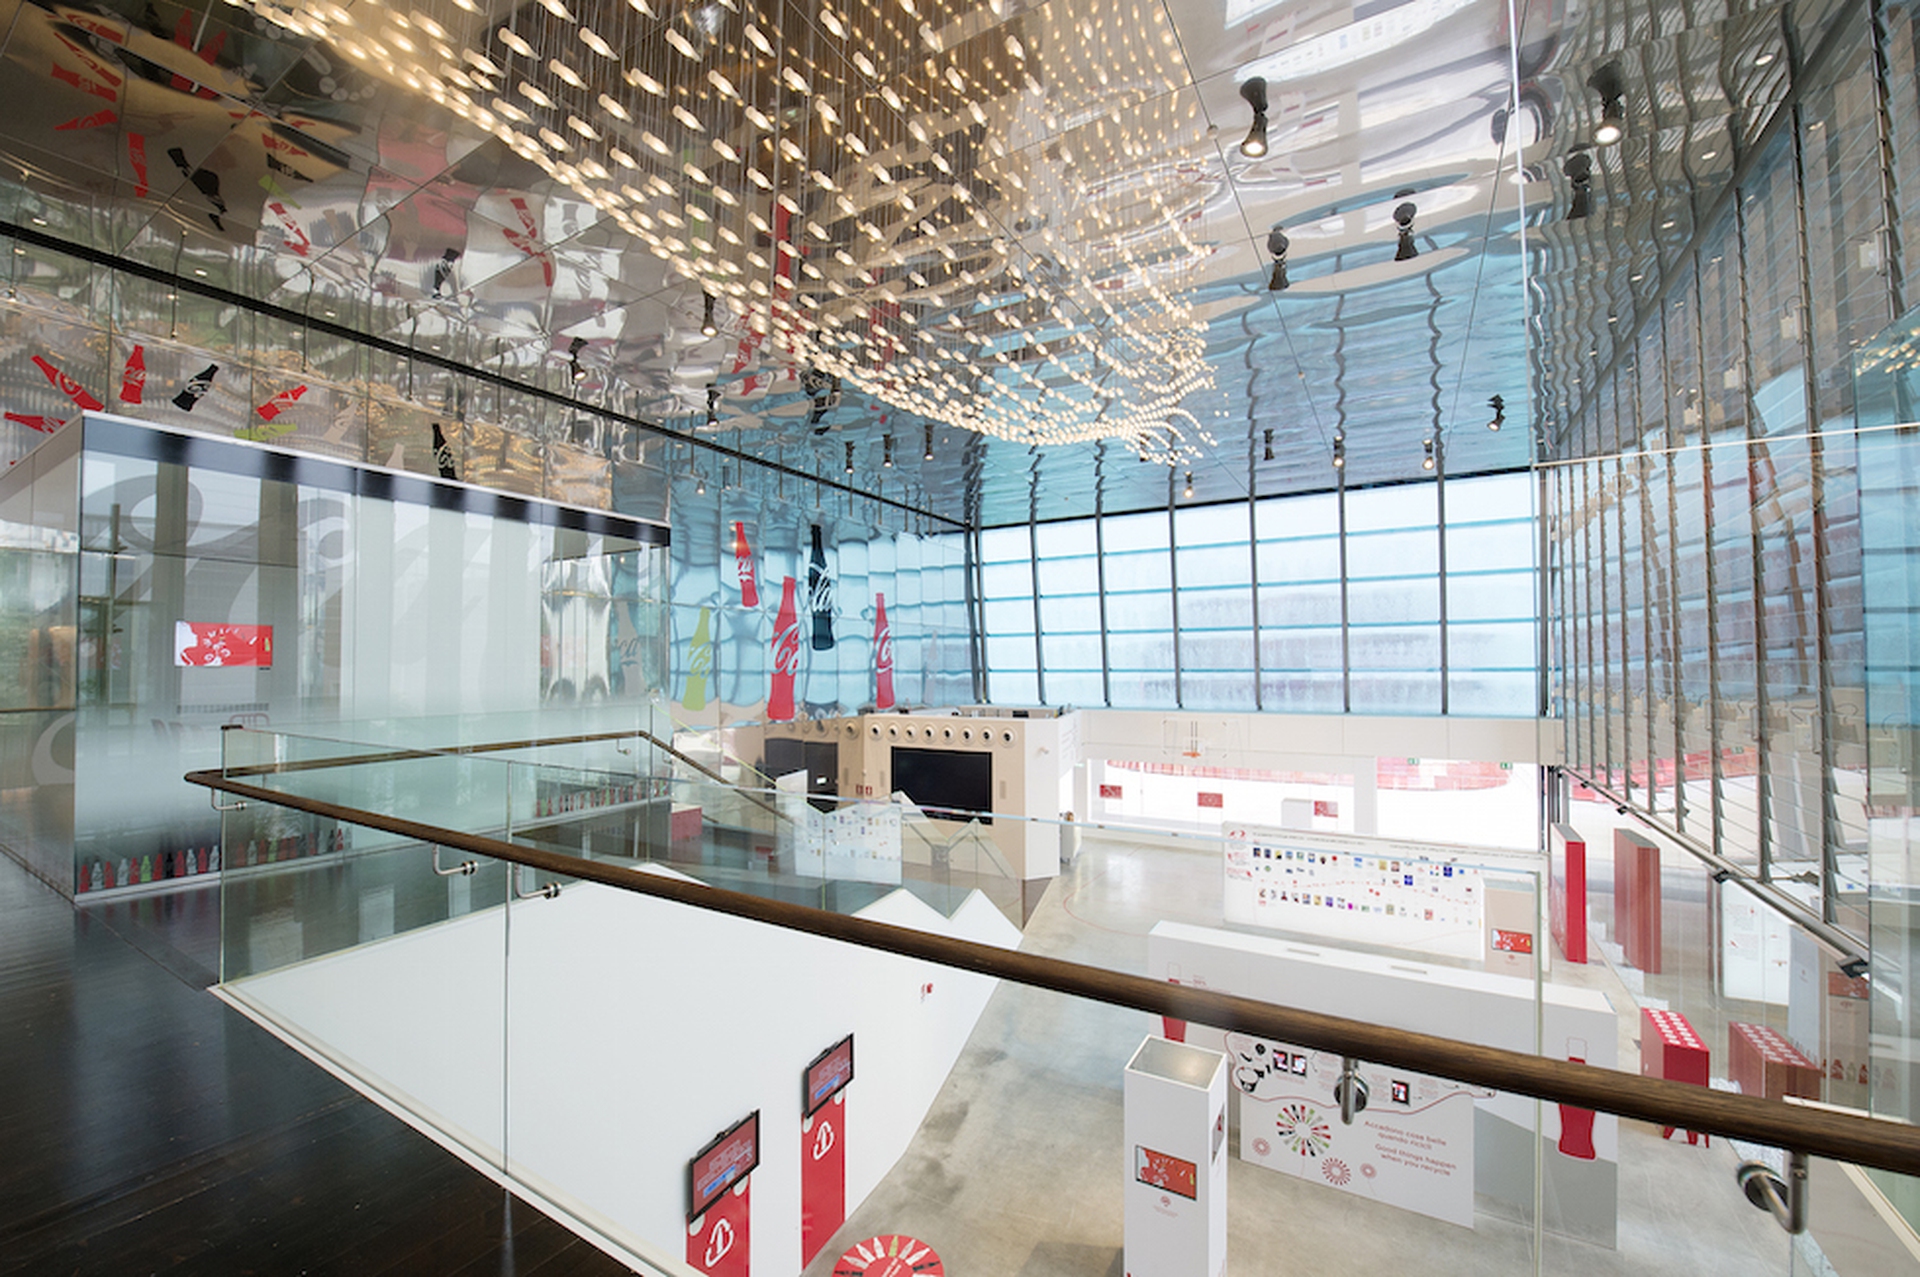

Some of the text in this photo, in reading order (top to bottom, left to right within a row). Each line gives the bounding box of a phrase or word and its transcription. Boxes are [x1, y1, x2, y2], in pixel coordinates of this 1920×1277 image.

[1378, 1132, 1408, 1144] quando
[1406, 1131, 1424, 1140] cose
[1426, 1136, 1446, 1146] belle
[1375, 1143, 1456, 1169] Good things happen
[1381, 1153, 1450, 1176] when you recycle
